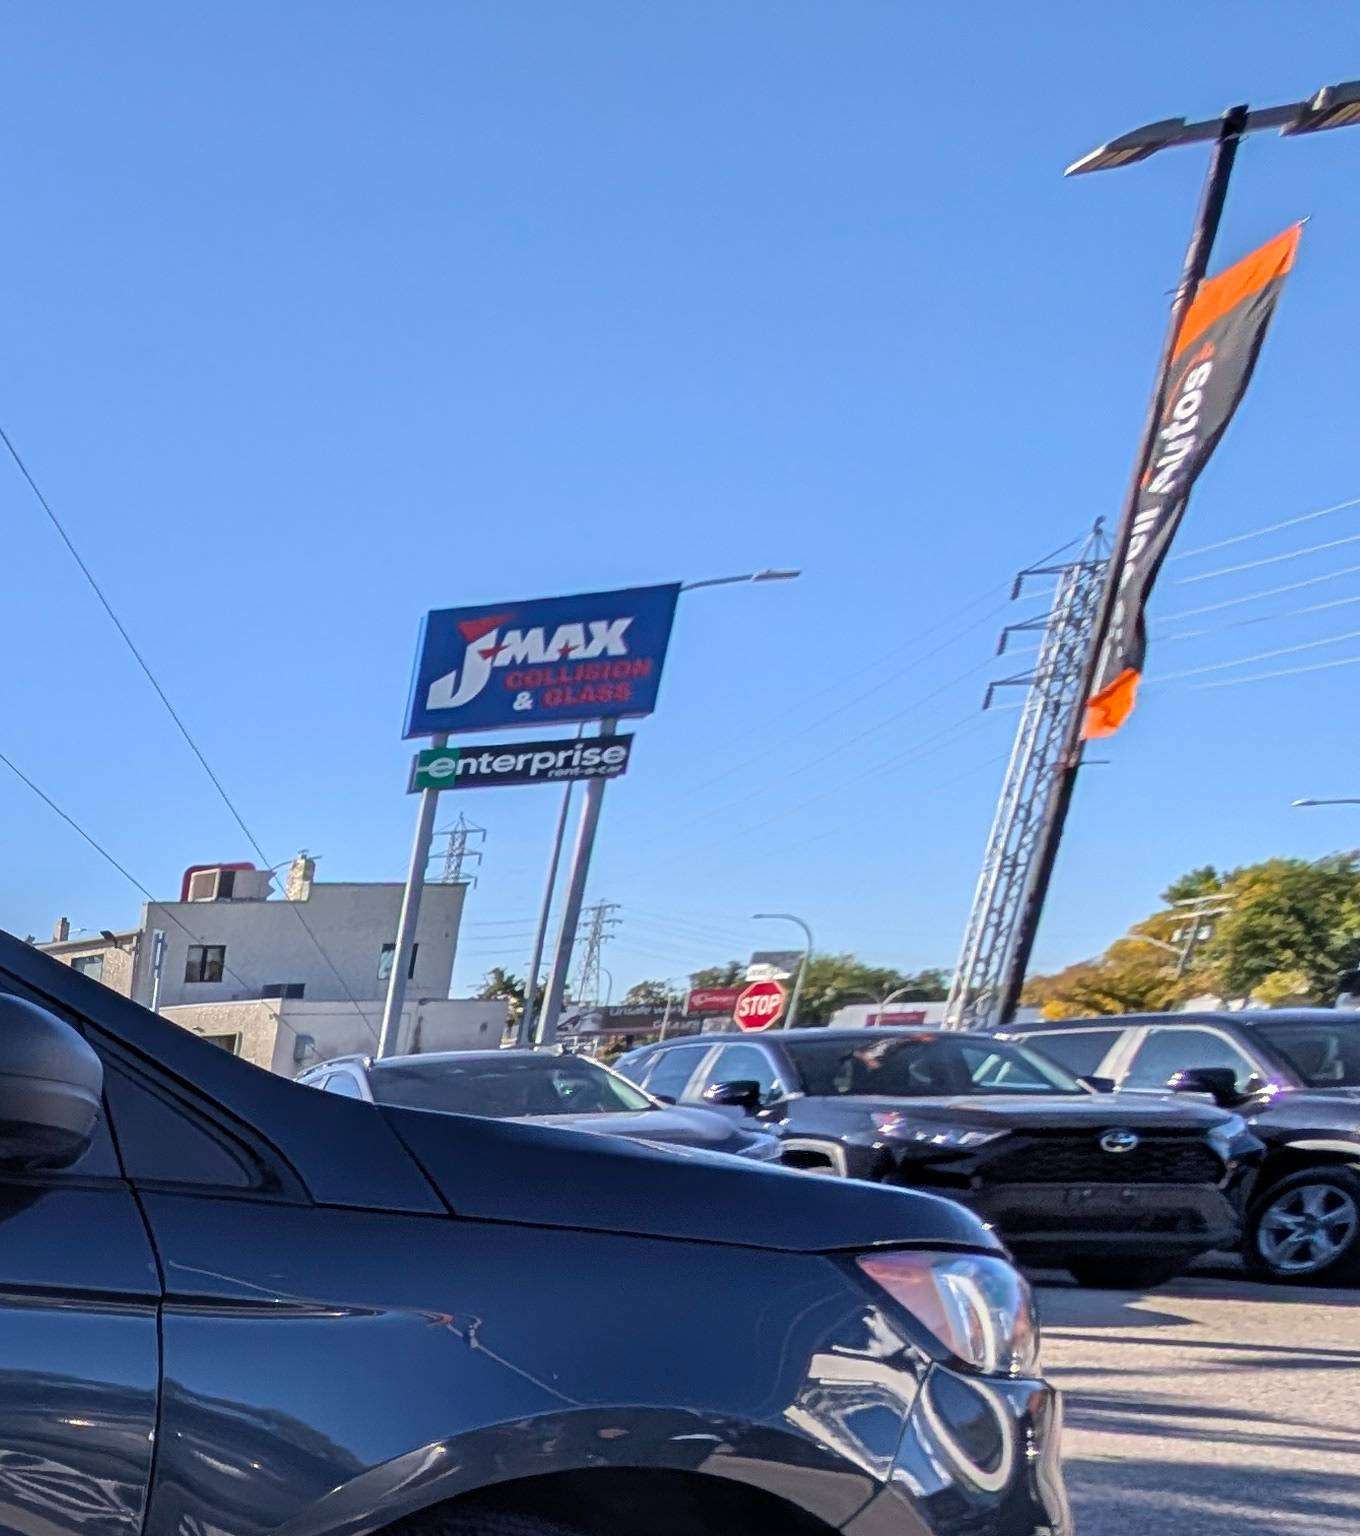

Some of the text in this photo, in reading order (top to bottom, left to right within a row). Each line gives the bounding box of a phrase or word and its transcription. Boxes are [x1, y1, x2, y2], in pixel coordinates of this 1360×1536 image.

[1148, 360, 1213, 493] Autos
[504, 658, 651, 690] COLLISION
[512, 682, 631, 711] & GLASS
[418, 743, 626, 777] enterprise
[739, 993, 782, 1017] STOP
